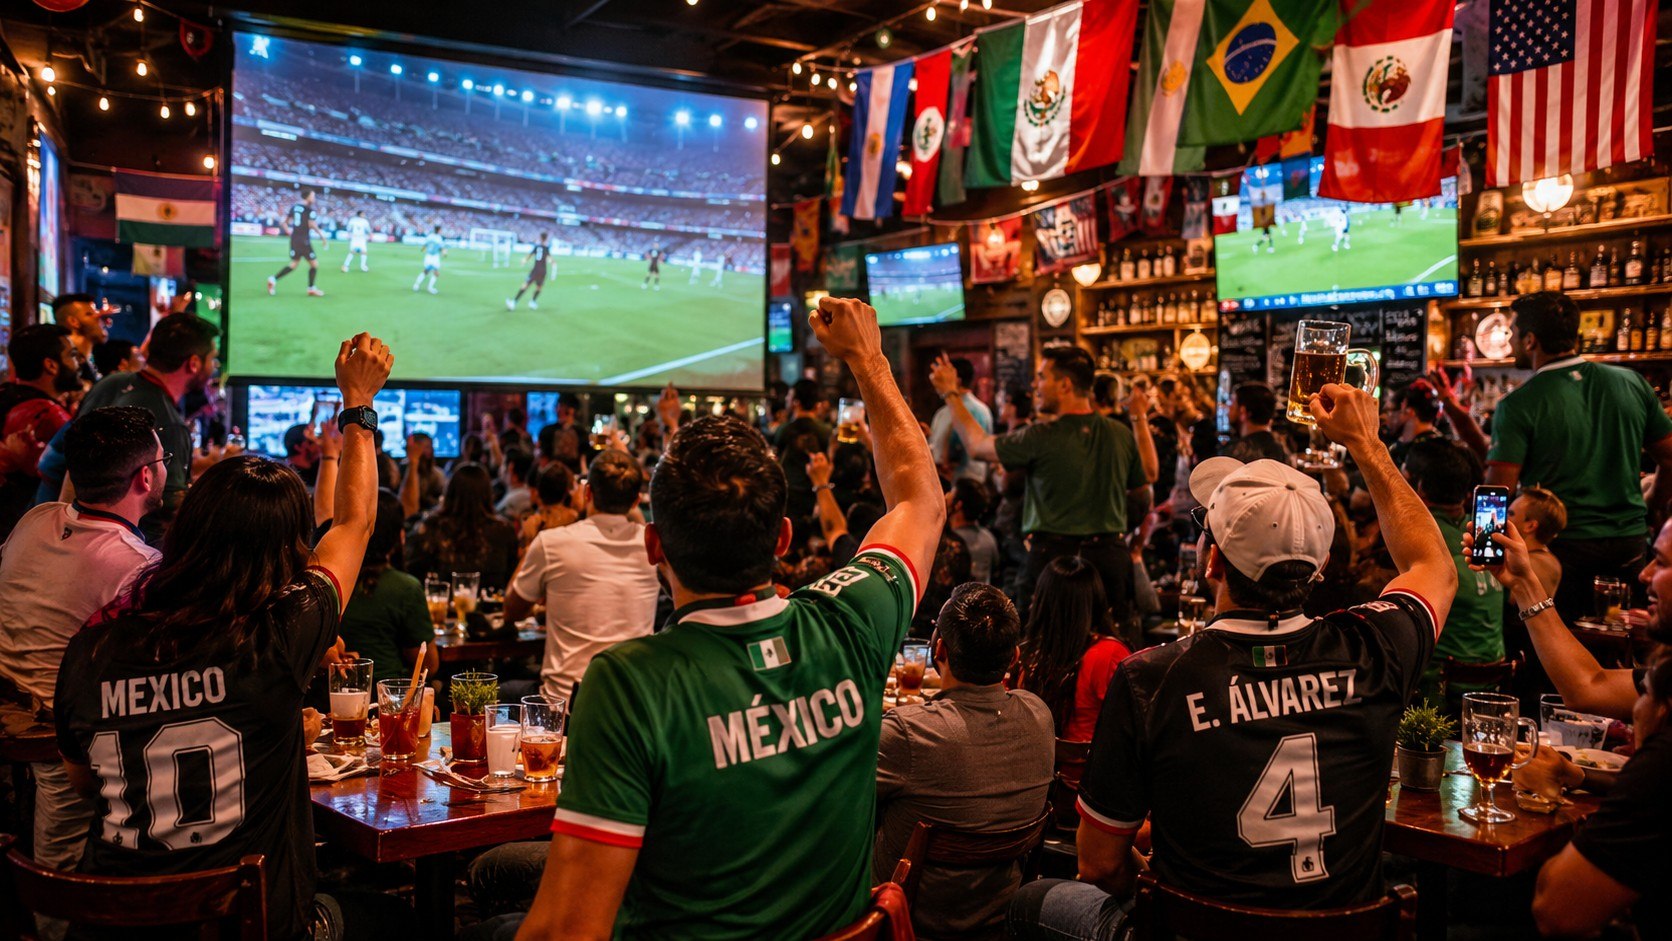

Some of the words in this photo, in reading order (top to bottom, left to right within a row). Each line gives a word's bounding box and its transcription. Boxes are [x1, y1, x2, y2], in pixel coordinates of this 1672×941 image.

[101, 666, 227, 719] MEXICO
[707, 679, 864, 769] MÉXICO
[1186, 692, 1221, 732] E.
[1229, 669, 1362, 724] ÁLVAREZ
[88, 716, 246, 851] 10
[1236, 732, 1337, 883] 4
